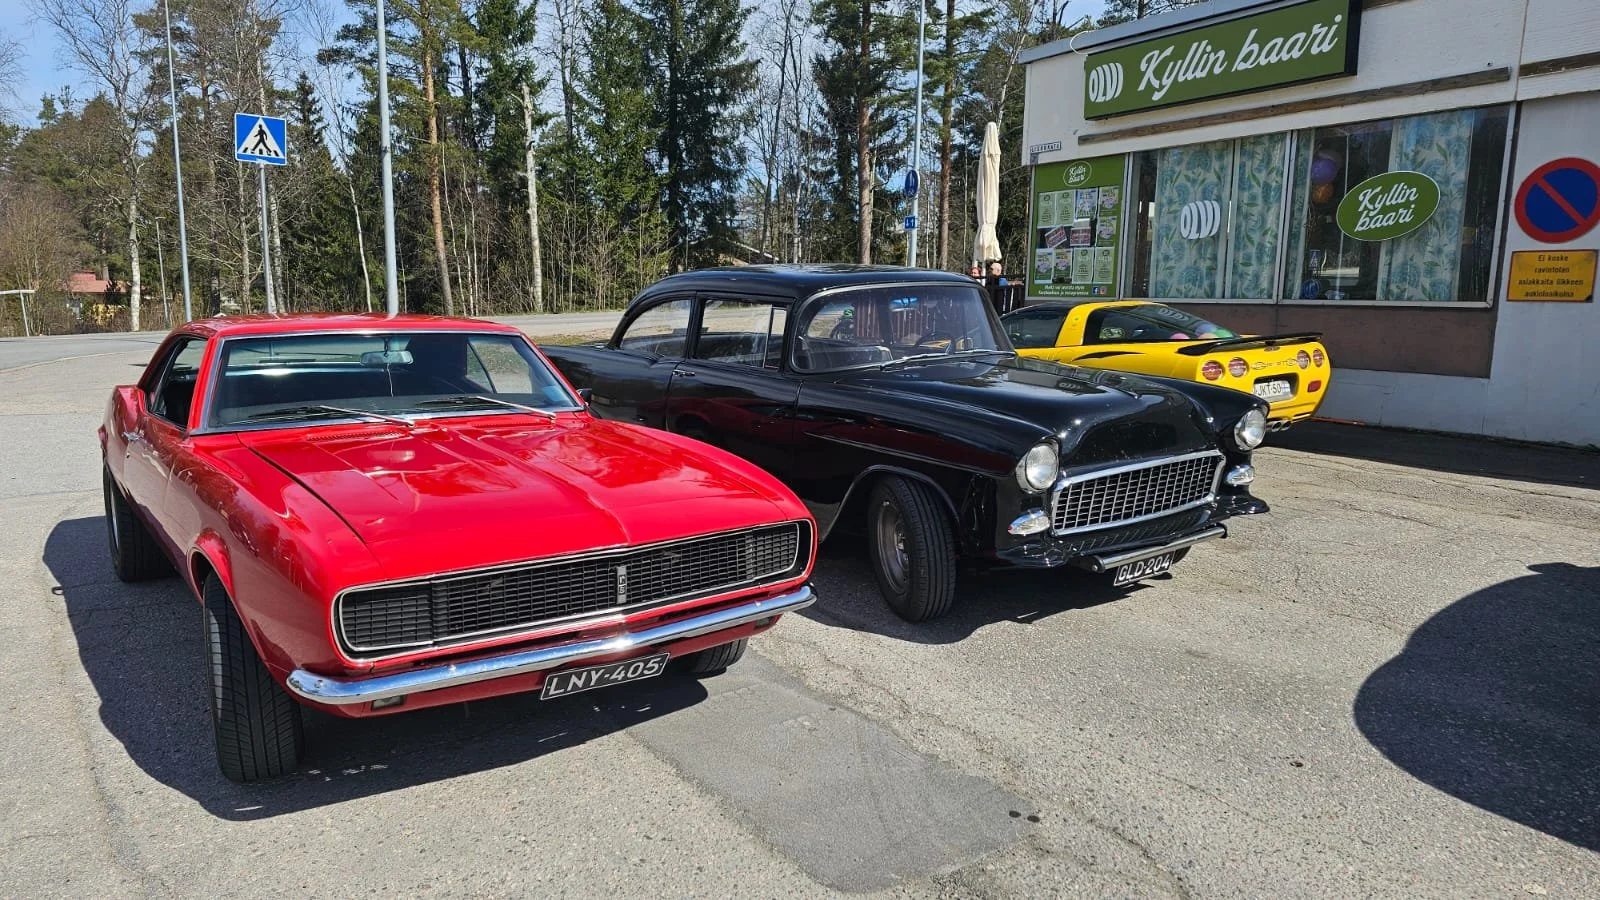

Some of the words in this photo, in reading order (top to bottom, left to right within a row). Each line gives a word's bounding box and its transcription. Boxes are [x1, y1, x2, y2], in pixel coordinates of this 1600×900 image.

[1088, 63, 1124, 103] OLVI
[1137, 40, 1228, 101] Kyllin
[1231, 14, 1342, 72] baari
[1358, 182, 1419, 216] Kyllin
[1180, 200, 1221, 240] OLVI
[1354, 204, 1416, 232] baari
[1538, 254, 1545, 262] Ei
[1547, 254, 1569, 262] koske
[1118, 553, 1170, 581] GLD-204
[548, 657, 661, 696] LNY-405
